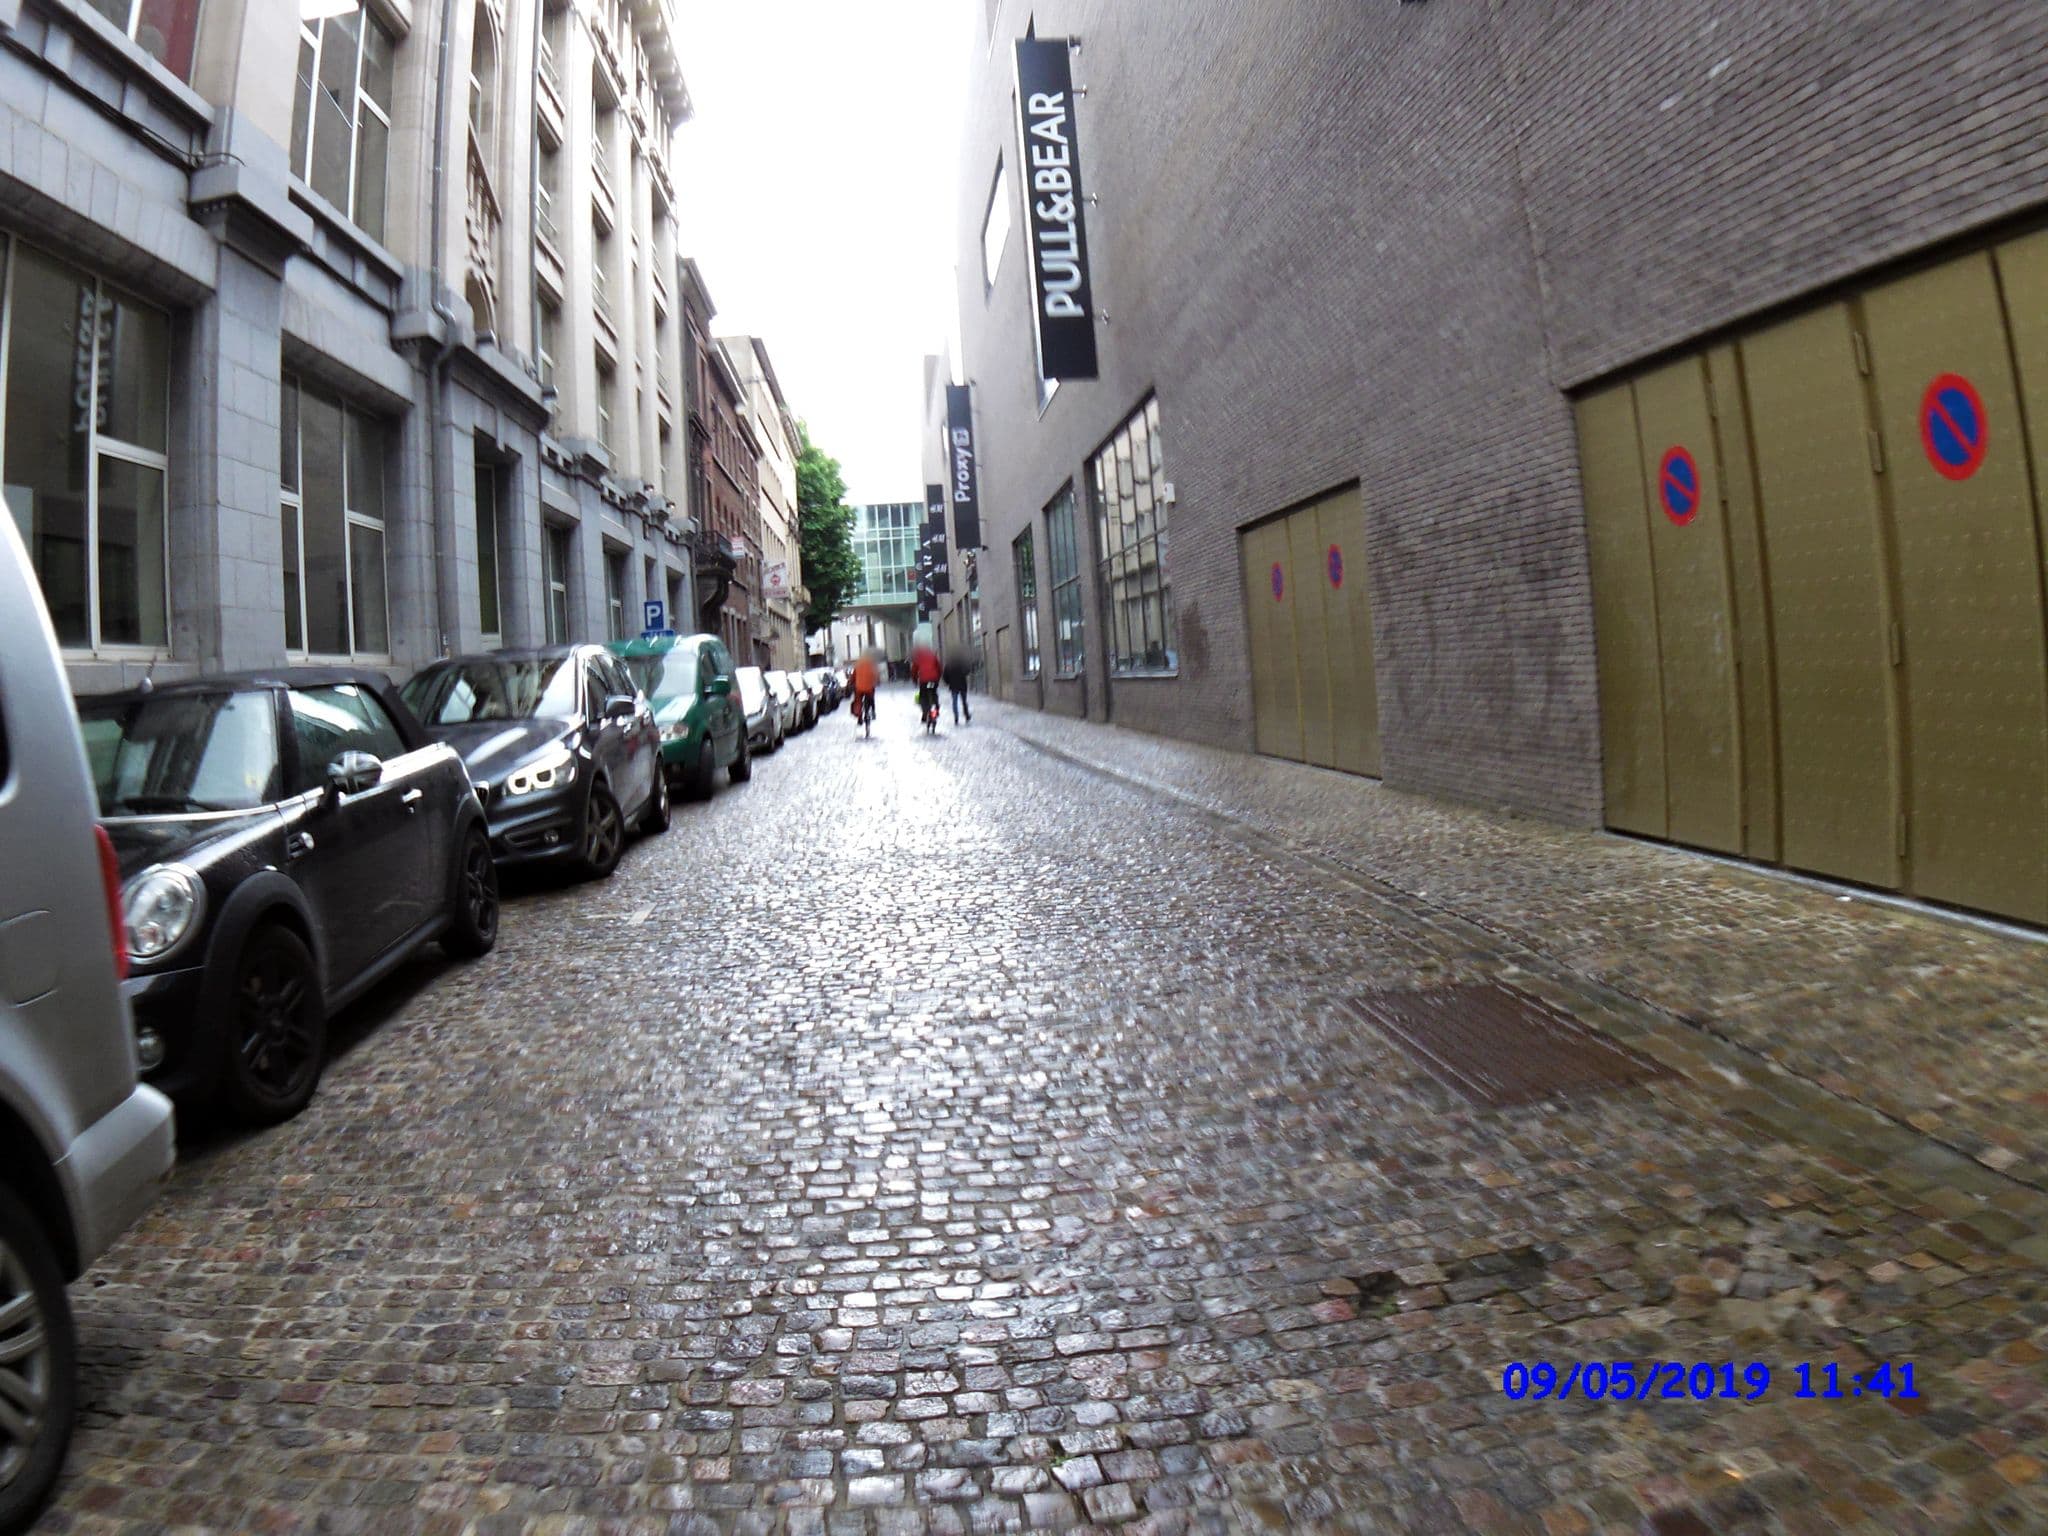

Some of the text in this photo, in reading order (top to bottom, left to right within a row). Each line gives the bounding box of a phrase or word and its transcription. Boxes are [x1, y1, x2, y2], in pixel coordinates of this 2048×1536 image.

[1028, 91, 1085, 318] PULL&BEAR
[954, 447, 973, 502] Proxy
[646, 605, 661, 627] P
